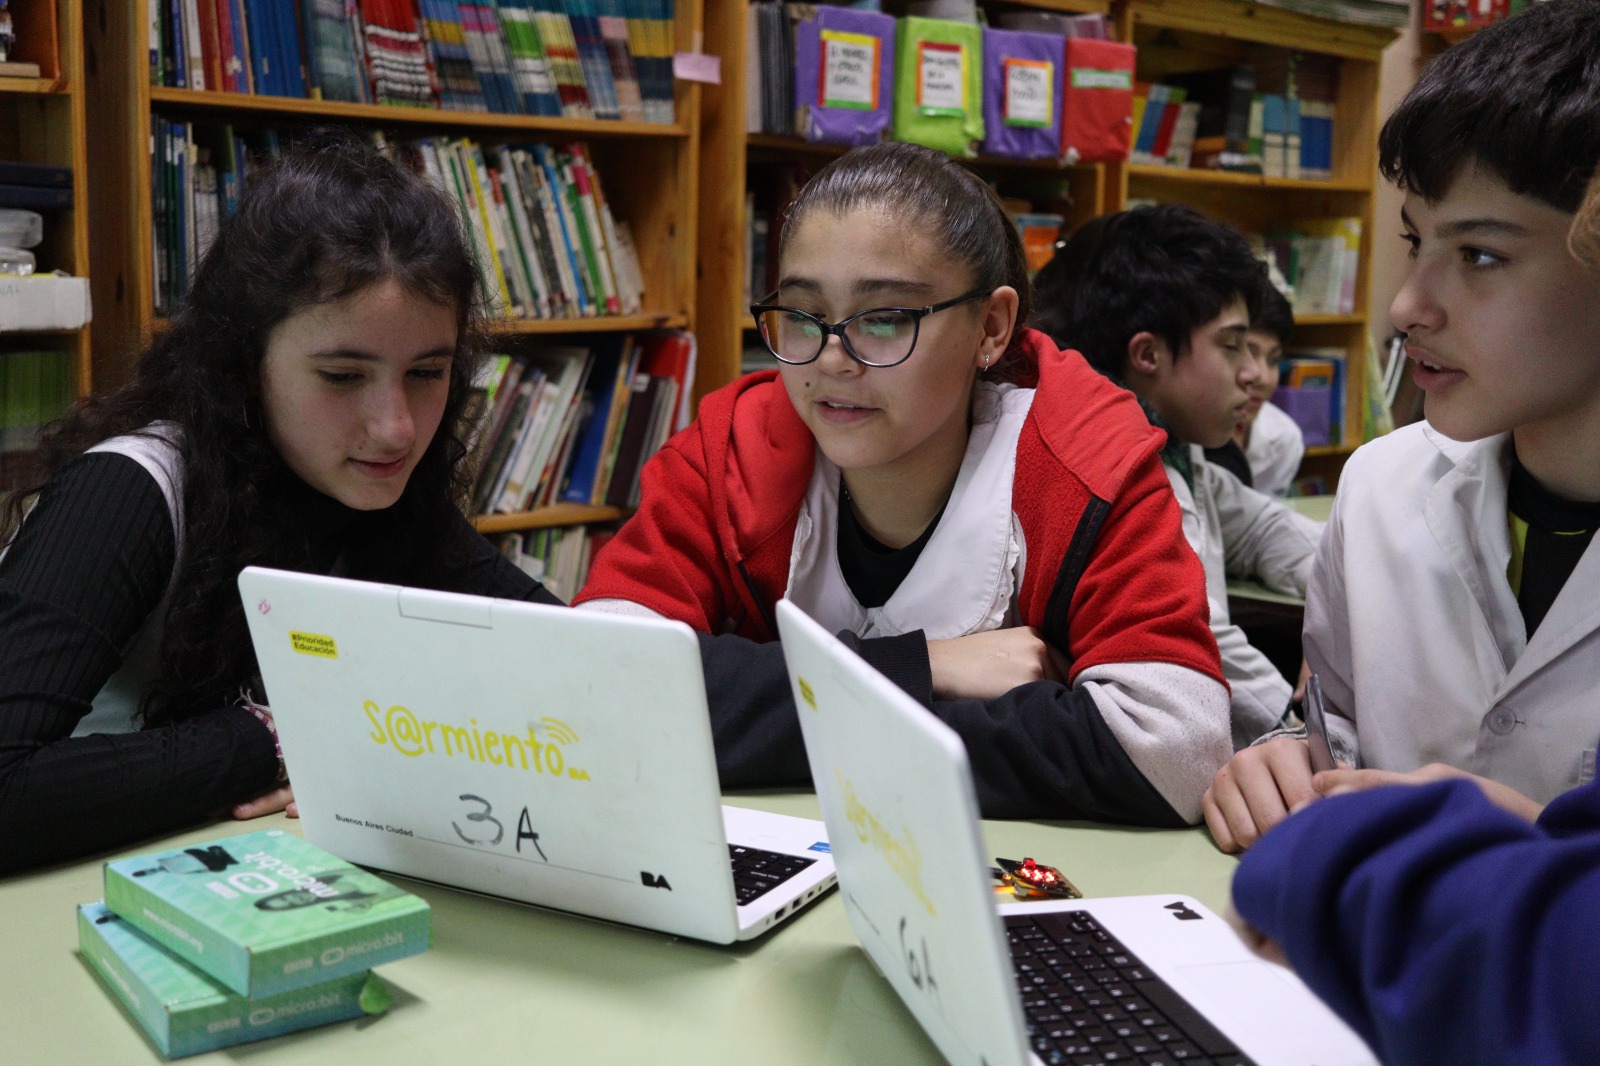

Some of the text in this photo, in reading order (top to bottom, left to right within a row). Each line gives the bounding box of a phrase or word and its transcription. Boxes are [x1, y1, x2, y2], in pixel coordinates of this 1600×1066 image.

[294, 642, 335, 655] Educación
[363, 699, 564, 777] S@rmiento
[335, 814, 414, 837] Buenos Aires Ciudad
